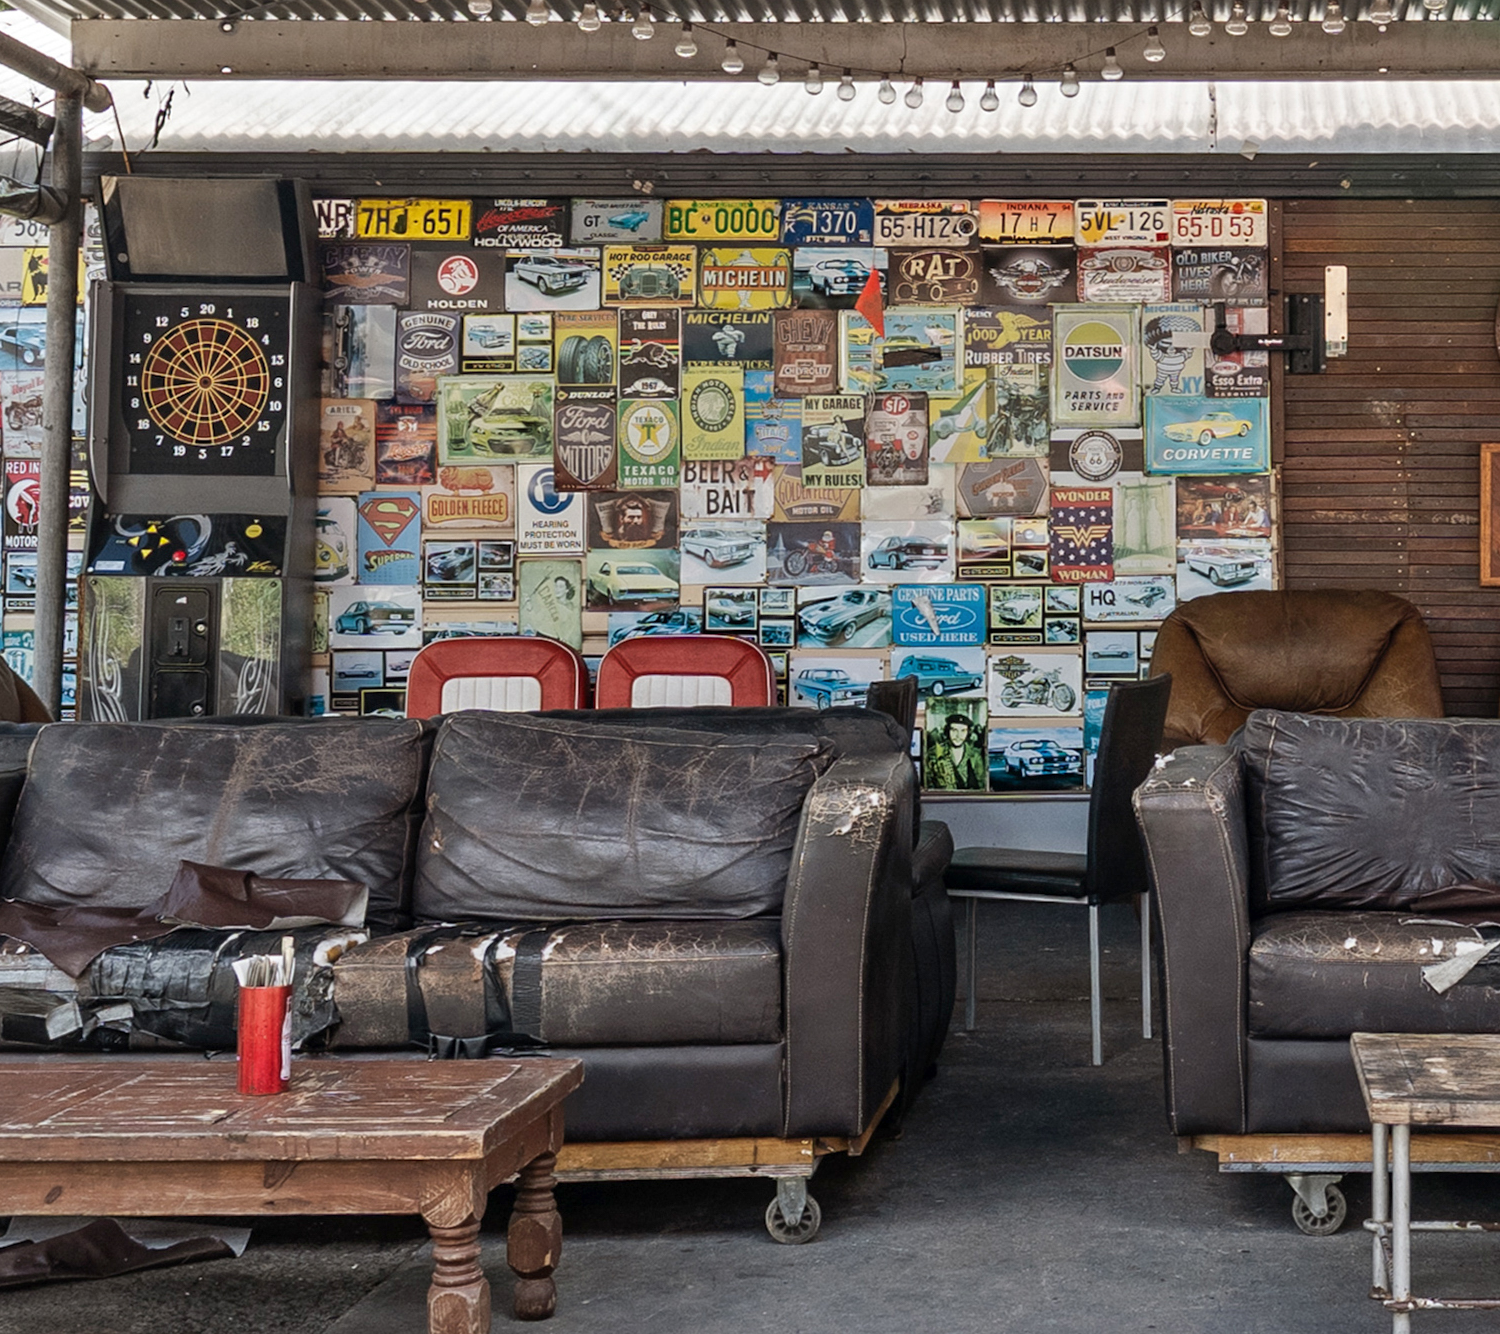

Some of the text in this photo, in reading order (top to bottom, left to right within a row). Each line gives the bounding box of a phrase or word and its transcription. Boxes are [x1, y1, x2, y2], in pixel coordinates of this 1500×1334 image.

[806, 202, 850, 211] KANSAS
[898, 202, 943, 210] NEBRASKA
[1006, 203, 1049, 211] INDIANA
[584, 215, 600, 229] GT
[669, 208, 775, 234] BC 0000
[811, 211, 857, 234] 1370
[1000, 213, 1057, 234] 17 7
[1230, 217, 1255, 237] 53
[474, 237, 563, 247] HOLLYWOOD
[609, 252, 692, 262] HOT ROD GARAGE
[1177, 251, 1232, 265] OLD BIKER
[910, 254, 962, 280] RAT
[1179, 267, 1212, 280] LIVES
[703, 270, 788, 288] MICHELIN
[1086, 271, 1161, 286] Budweiser
[1180, 279, 1210, 291] HERE
[428, 299, 488, 309] HOLDEN
[1145, 305, 1200, 314] MICHELIN
[403, 313, 454, 330] GENUINE
[687, 314, 770, 325] MICHELIN
[778, 318, 835, 344] CHEVY
[1020, 327, 1051, 341] YEAR
[403, 334, 449, 353] Ford
[965, 350, 1051, 365] RUBBER TIRES
[1065, 346, 1123, 358] DATSUN
[1212, 375, 1263, 386] Esso Extra
[568, 390, 614, 401] DUNLOP
[1064, 390, 1101, 401] PARTS
[804, 396, 863, 411] MY GARAGE
[884, 398, 911, 413] STP
[1071, 401, 1119, 413] SERVICE
[329, 406, 358, 415] ARIEL
[560, 407, 610, 431] Ford
[634, 417, 665, 425] TEXACO
[1162, 447, 1254, 462] CORVETTE
[623, 465, 675, 477] TEXACO
[683, 462, 736, 484] BEER
[624, 477, 675, 486] MOTOR OIL
[805, 473, 864, 487] MY RULES!
[706, 489, 757, 515] BAIT
[1055, 491, 1111, 503] WONDER
[430, 498, 504, 517] GOLDEN FLEECE
[531, 520, 569, 530] HEARING
[524, 530, 577, 540] PROTECTION
[520, 541, 582, 550] MUST WORN
[368, 550, 416, 573] SUPERMAN
[1057, 569, 1109, 582] WOMAN
[944, 587, 980, 601] PARTS
[1090, 589, 1116, 607] HQ
[900, 632, 978, 642] USED HERE
